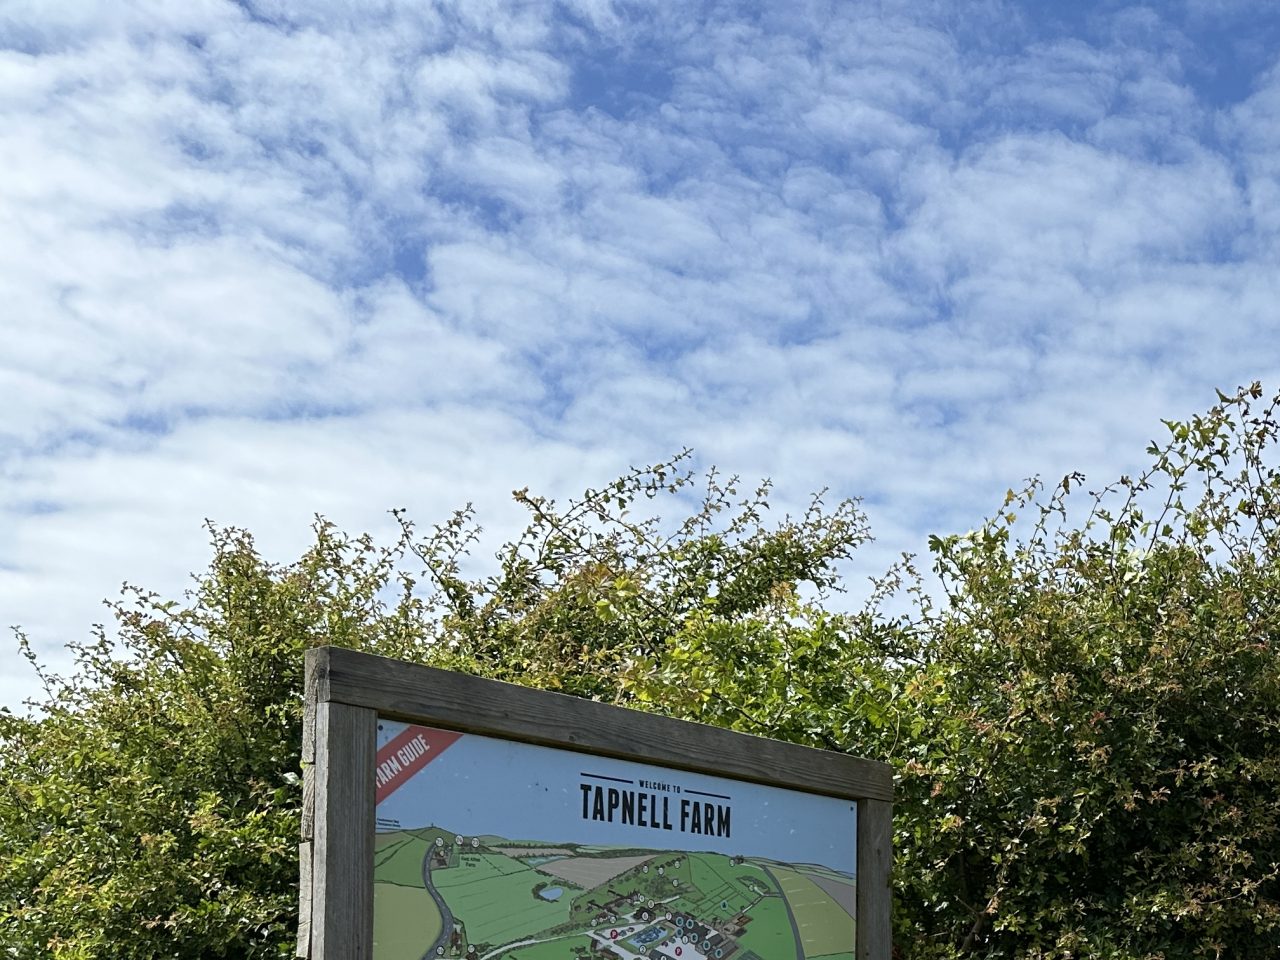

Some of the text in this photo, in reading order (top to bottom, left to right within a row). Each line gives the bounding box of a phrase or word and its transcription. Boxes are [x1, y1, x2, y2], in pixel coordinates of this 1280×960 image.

[397, 734, 430, 767] GUIDE
[639, 779, 681, 794] WELCOME TO
[580, 784, 731, 838] TAPNELL FARM
